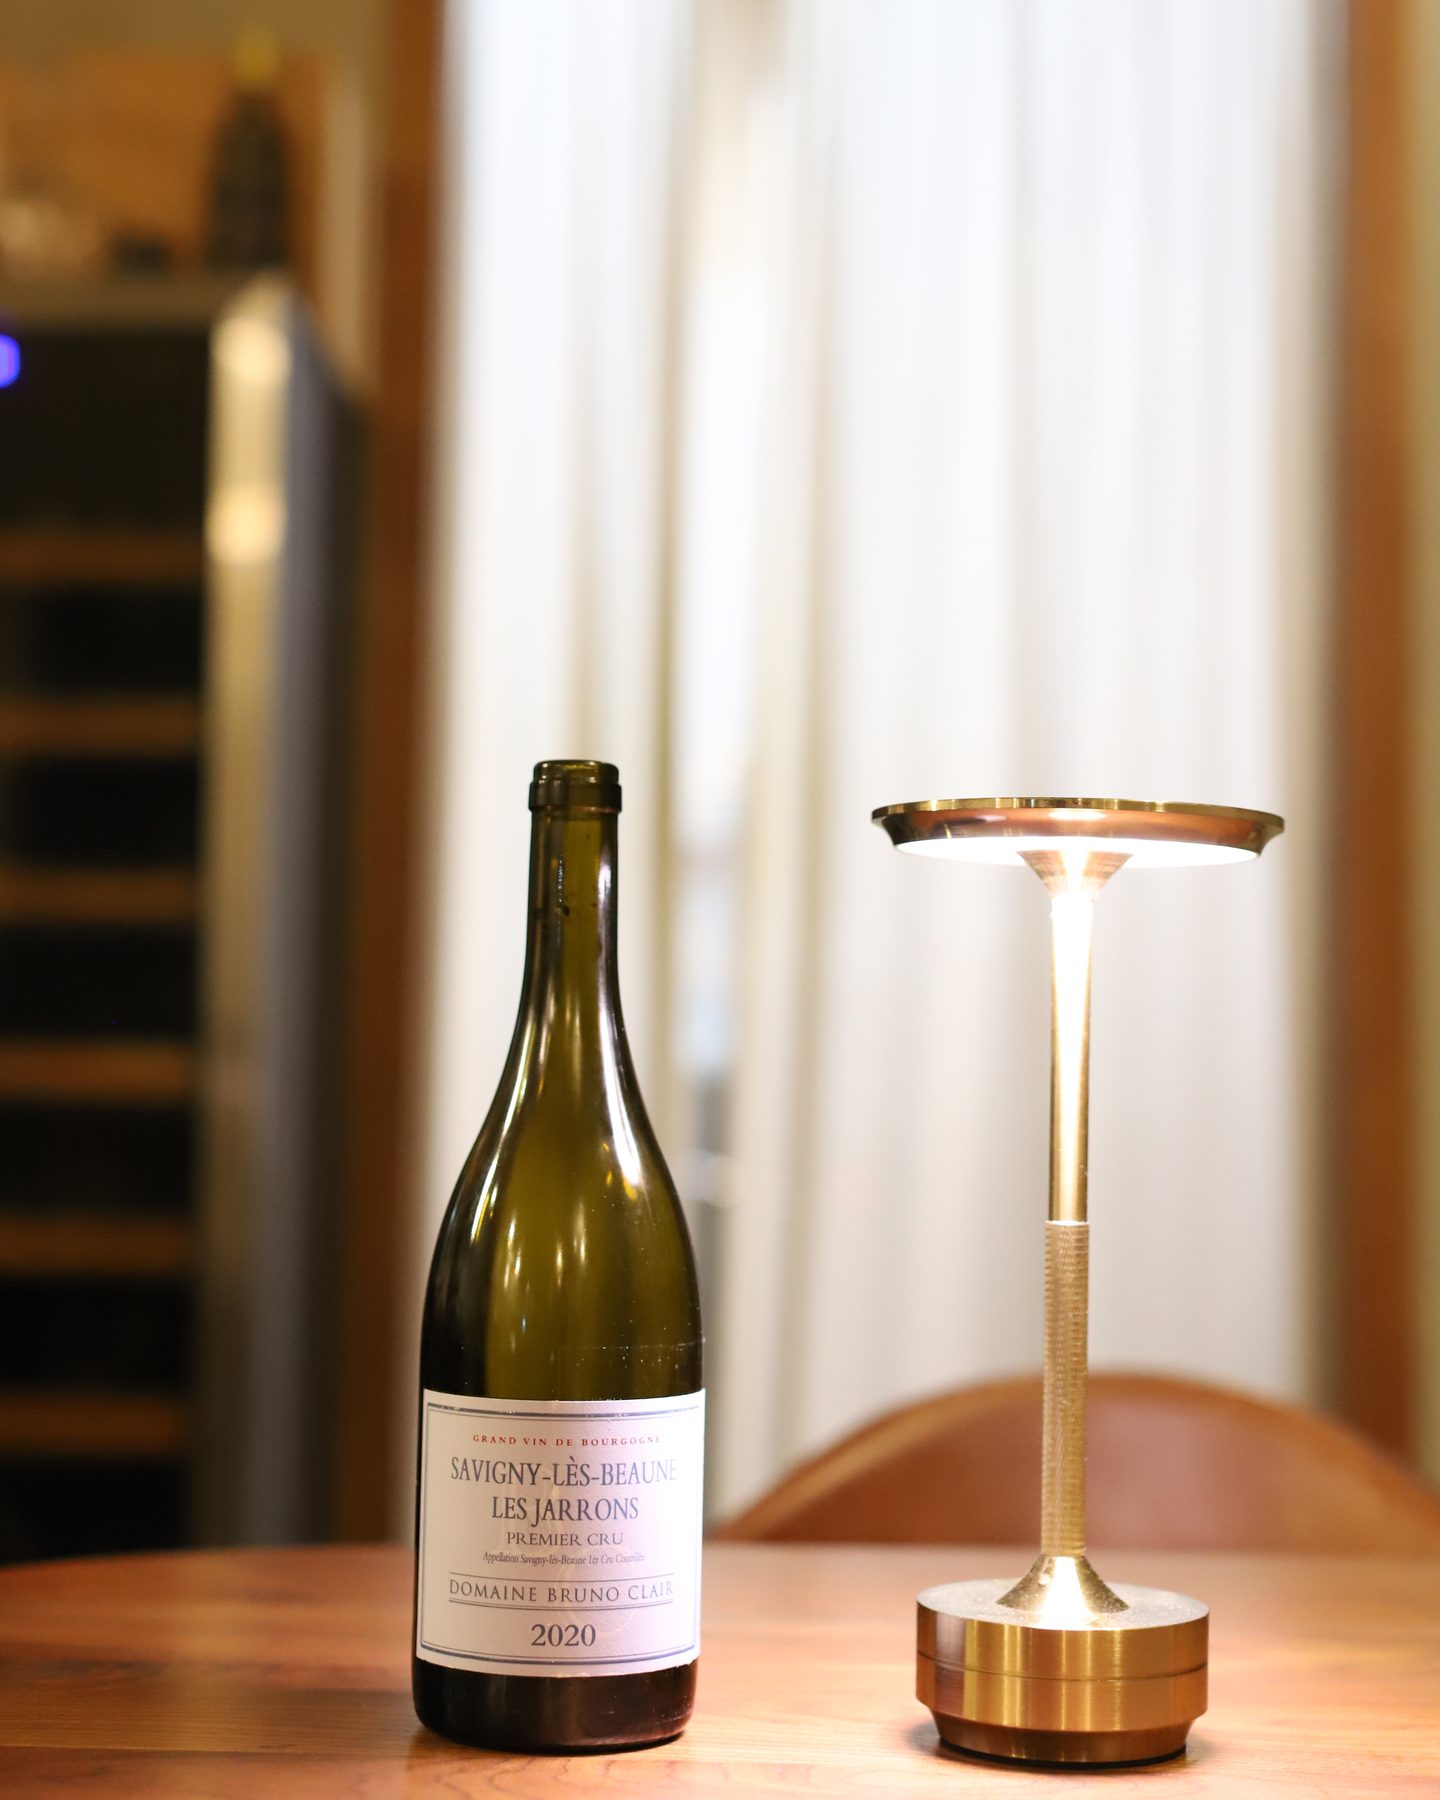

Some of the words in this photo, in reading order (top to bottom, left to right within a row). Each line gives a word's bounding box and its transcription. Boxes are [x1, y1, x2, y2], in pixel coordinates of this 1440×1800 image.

[473, 1434, 516, 1445] GRAND
[523, 1437, 547, 1446] VIN
[556, 1438, 573, 1447] DE
[582, 1436, 660, 1447] BOURGOGNE
[451, 1456, 677, 1487] SAVIGNY-LÈS-BEAUNE
[492, 1496, 527, 1520] LES
[531, 1497, 639, 1527] JARRONS
[507, 1532, 582, 1546] PREMIER
[587, 1533, 624, 1546] CRU
[483, 1552, 519, 1564] Appellation
[600, 1553, 614, 1564] Cru
[449, 1579, 537, 1602] DOMAINE
[548, 1586, 620, 1603] BRUNO
[628, 1581, 673, 1600] CLAIR
[531, 1624, 596, 1647] 2020
